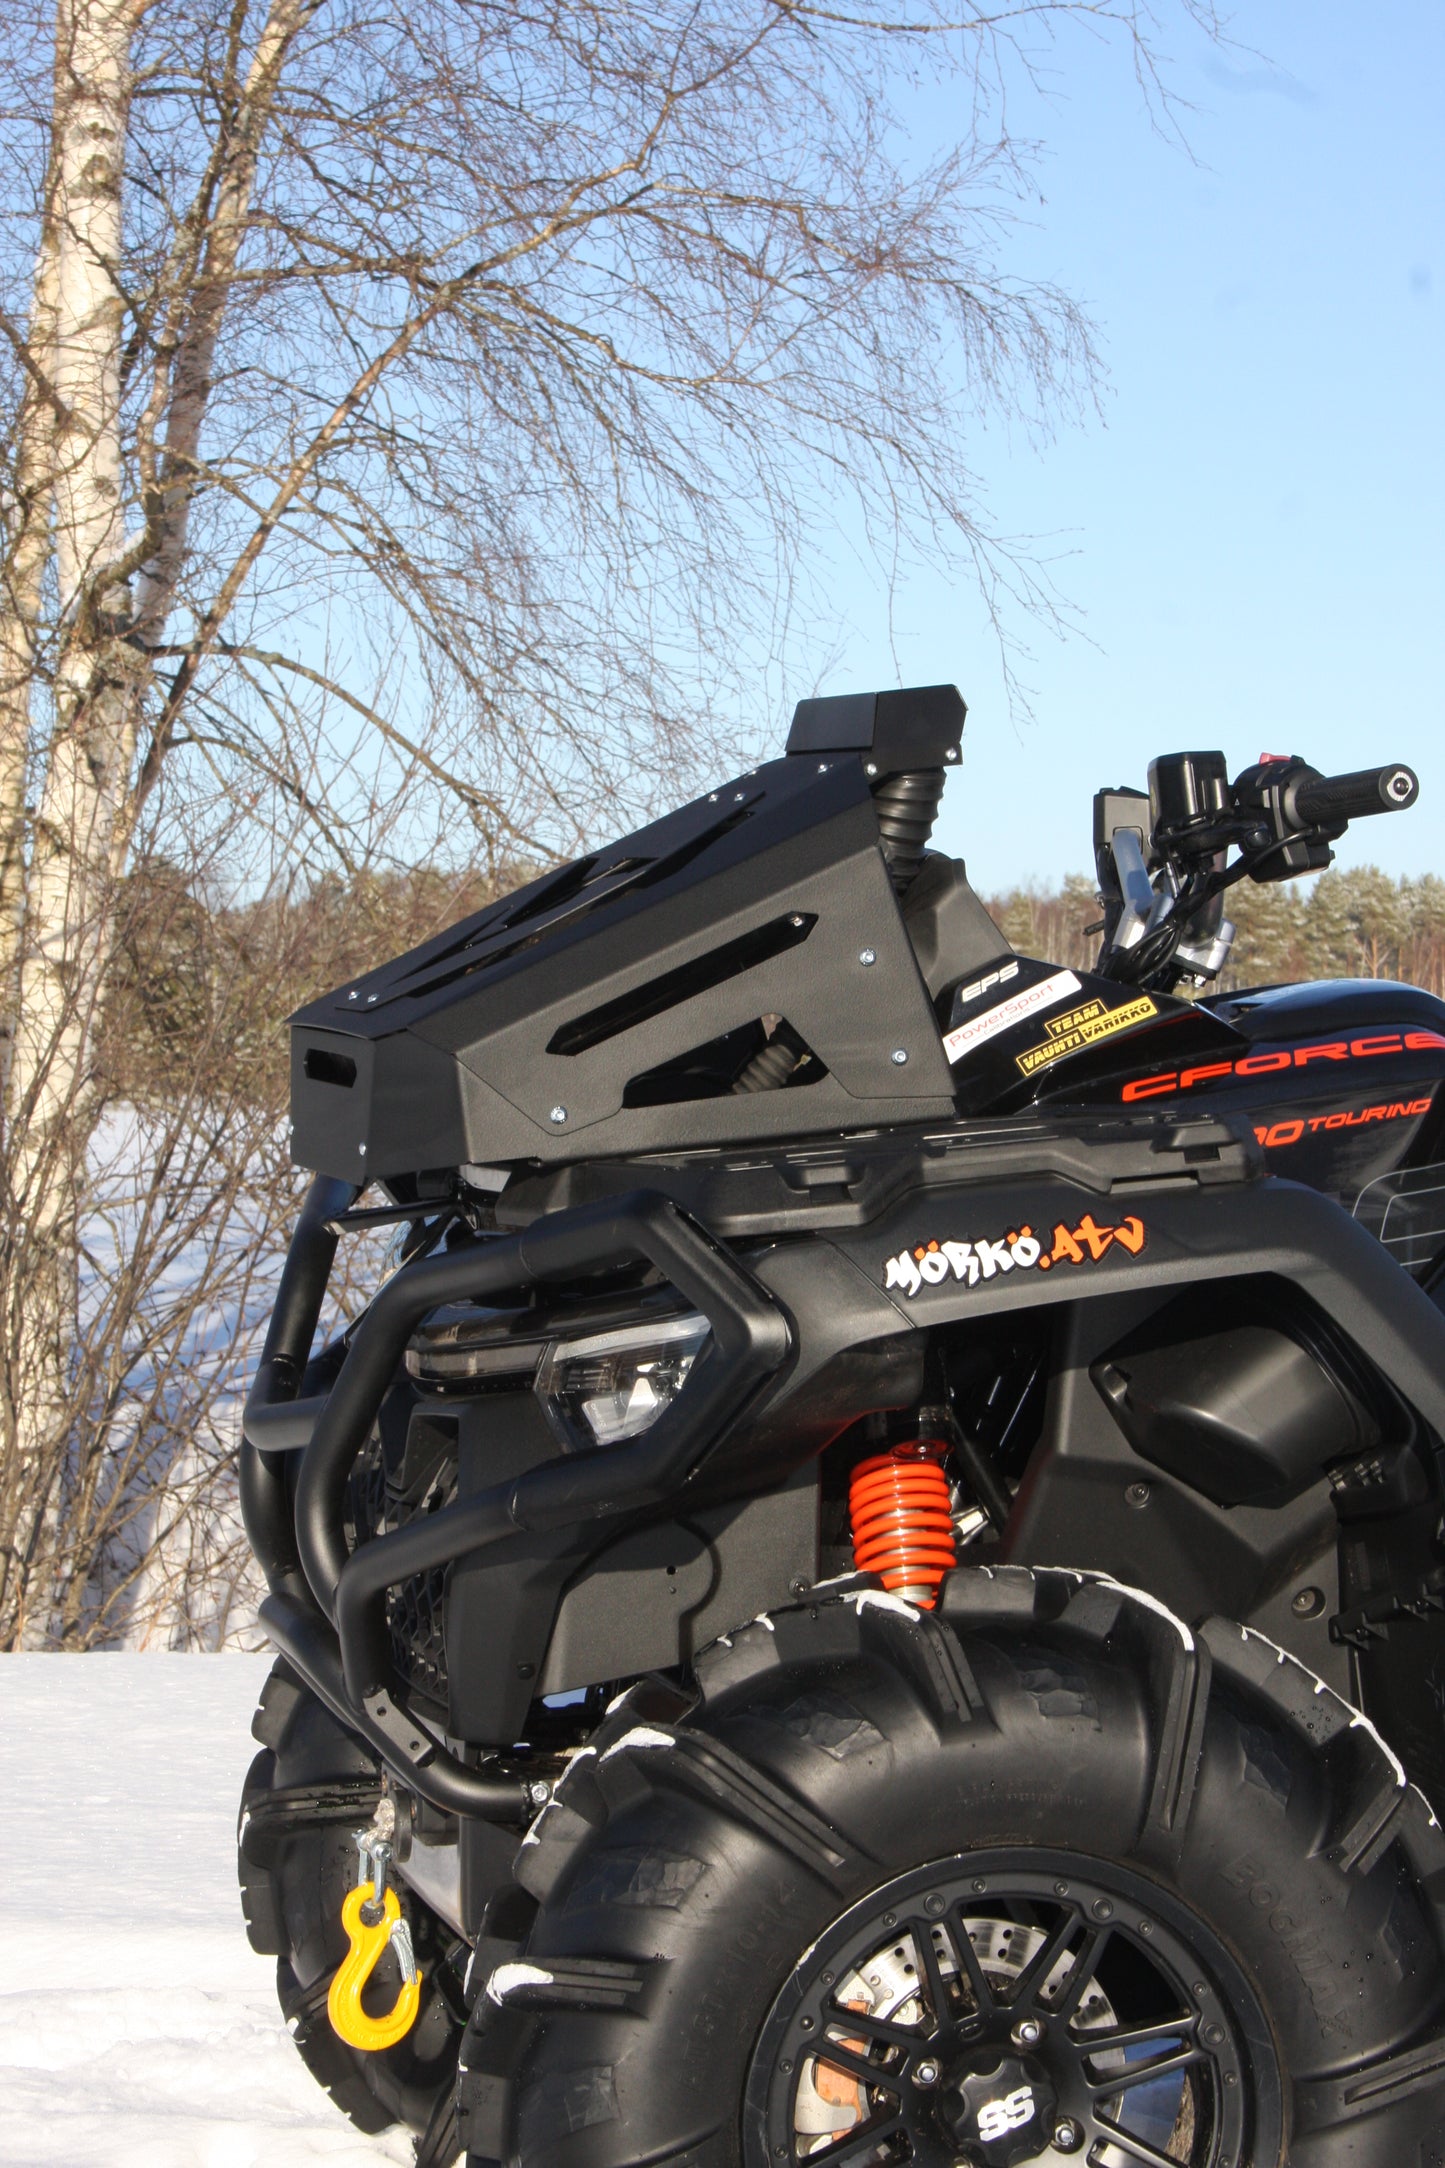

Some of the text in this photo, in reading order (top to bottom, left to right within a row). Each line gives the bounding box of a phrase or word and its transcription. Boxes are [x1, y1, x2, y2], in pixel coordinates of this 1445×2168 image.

[961, 961, 1019, 1003] EPS
[948, 984, 1053, 1047] PowerSport
[1022, 1002, 1151, 1070] VAUHTI VARIKKO
[1051, 1004, 1100, 1034] TEAM
[1121, 1032, 1445, 1103] CFORCE
[1308, 1097, 1432, 1132] TOURING
[977, 2085, 1035, 2142] SS
